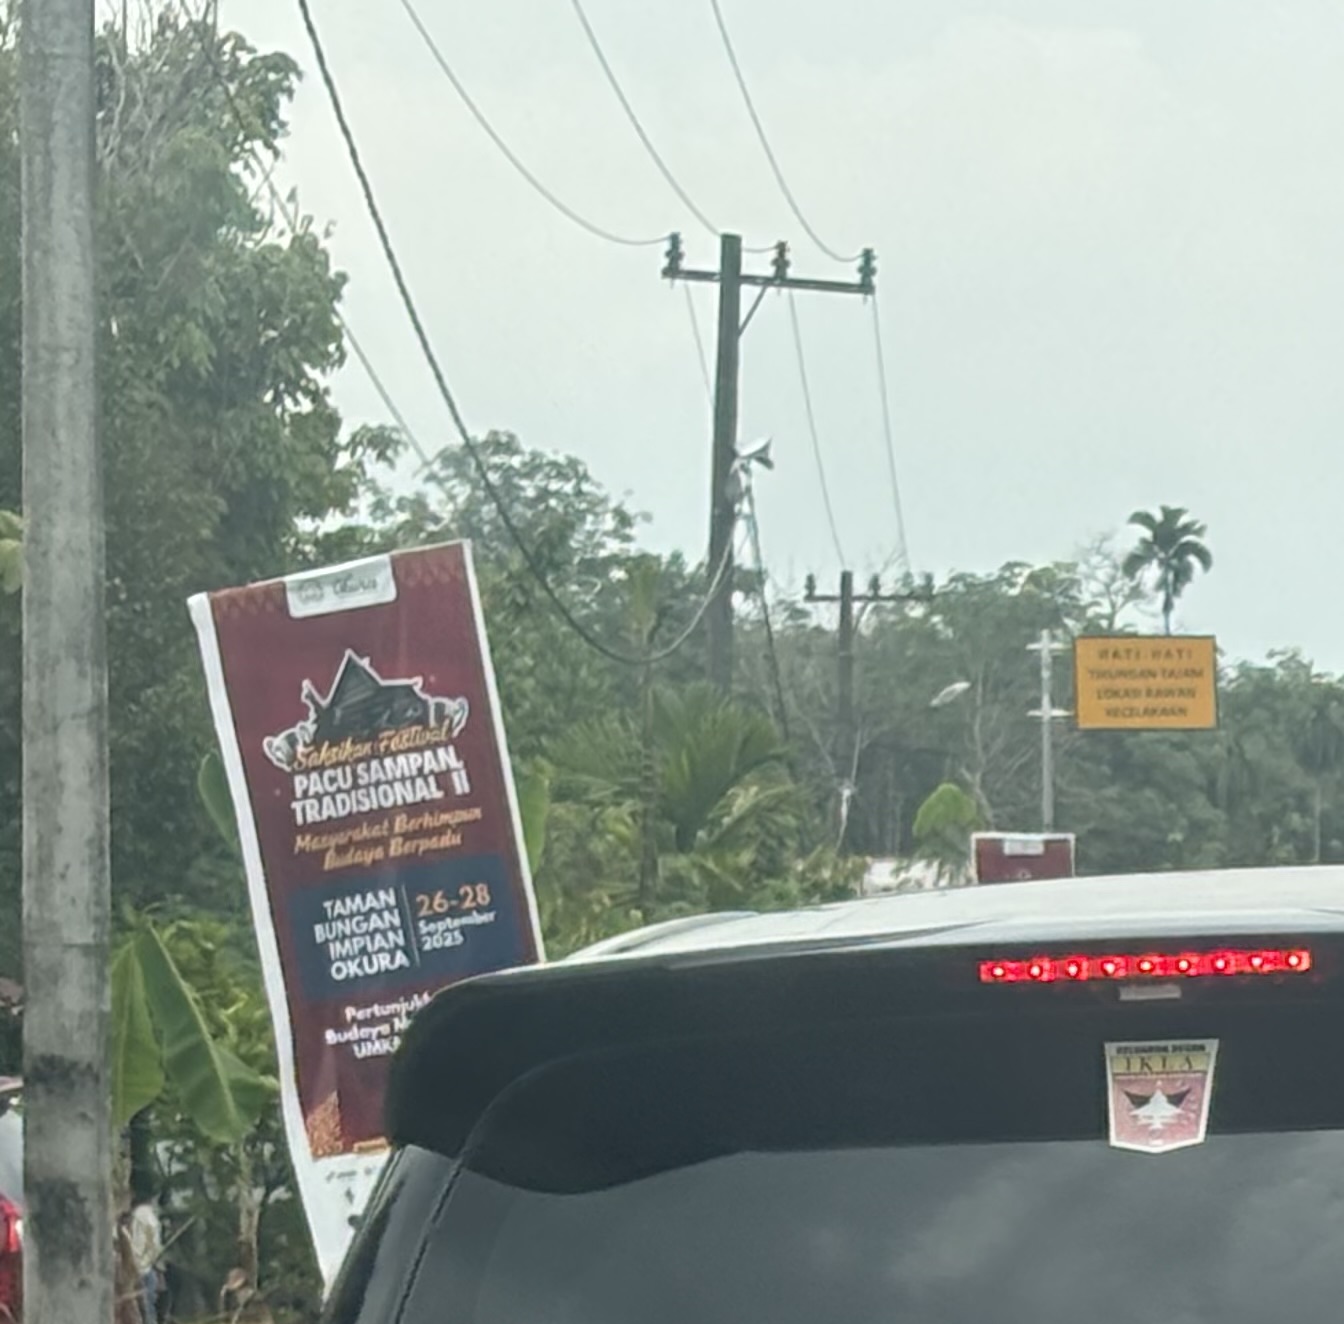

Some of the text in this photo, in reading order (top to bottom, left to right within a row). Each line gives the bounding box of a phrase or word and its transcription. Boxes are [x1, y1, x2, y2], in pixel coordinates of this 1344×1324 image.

[294, 719, 451, 770] Saksikan Festival
[291, 768, 471, 826] TRADISIONAL II
[294, 765, 353, 799] PACU
[294, 807, 483, 855] Masyarakat Berhimpun
[324, 831, 462, 871] Budaya Berpadu
[323, 887, 397, 919] TAMAN
[415, 883, 491, 917] 26-28
[313, 908, 401, 944] BUNGAN
[418, 910, 496, 936] September
[328, 929, 405, 961] IMPIAN
[420, 930, 464, 951] 2025
[330, 949, 410, 981] OKURA
[325, 1022, 391, 1046] Budaya
